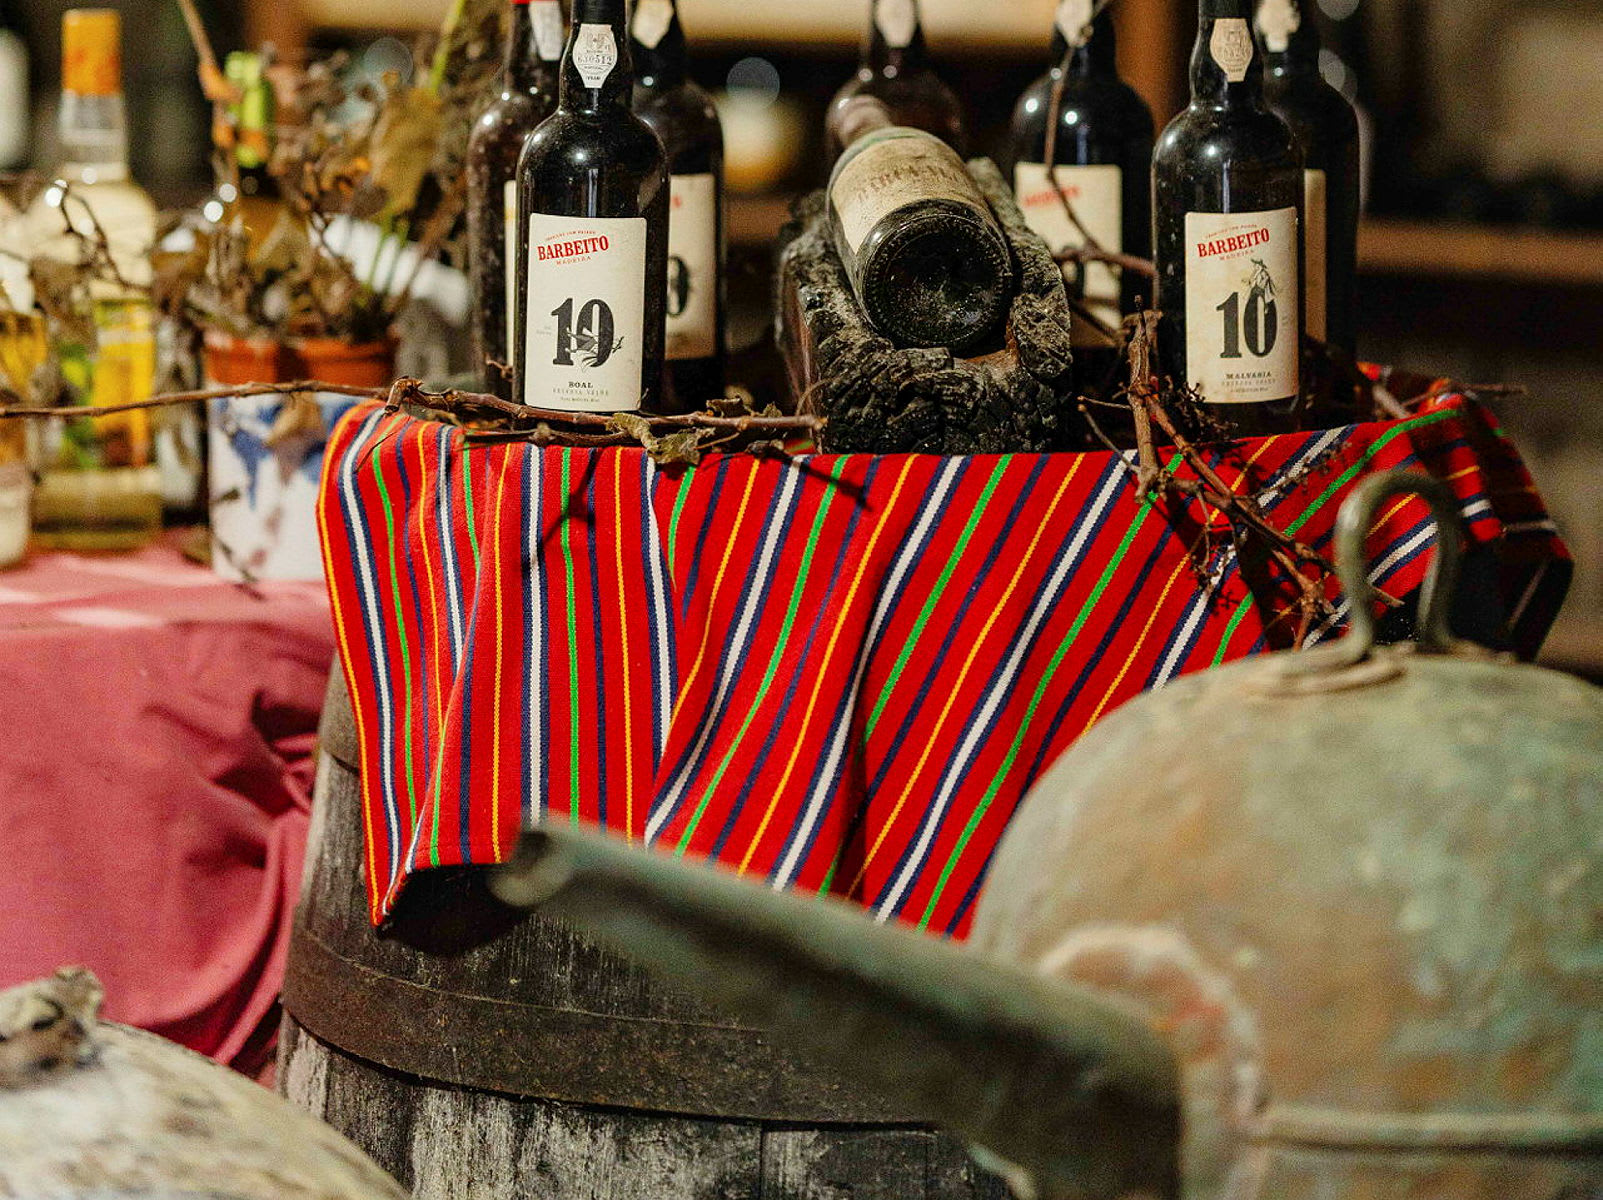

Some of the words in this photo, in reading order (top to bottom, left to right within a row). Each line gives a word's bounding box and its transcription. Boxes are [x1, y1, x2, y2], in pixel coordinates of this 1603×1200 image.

[537, 234, 609, 261] BARBEITO
[1197, 227, 1270, 257] BARBEITO
[550, 298, 615, 368] 10
[1216, 286, 1278, 358] 10
